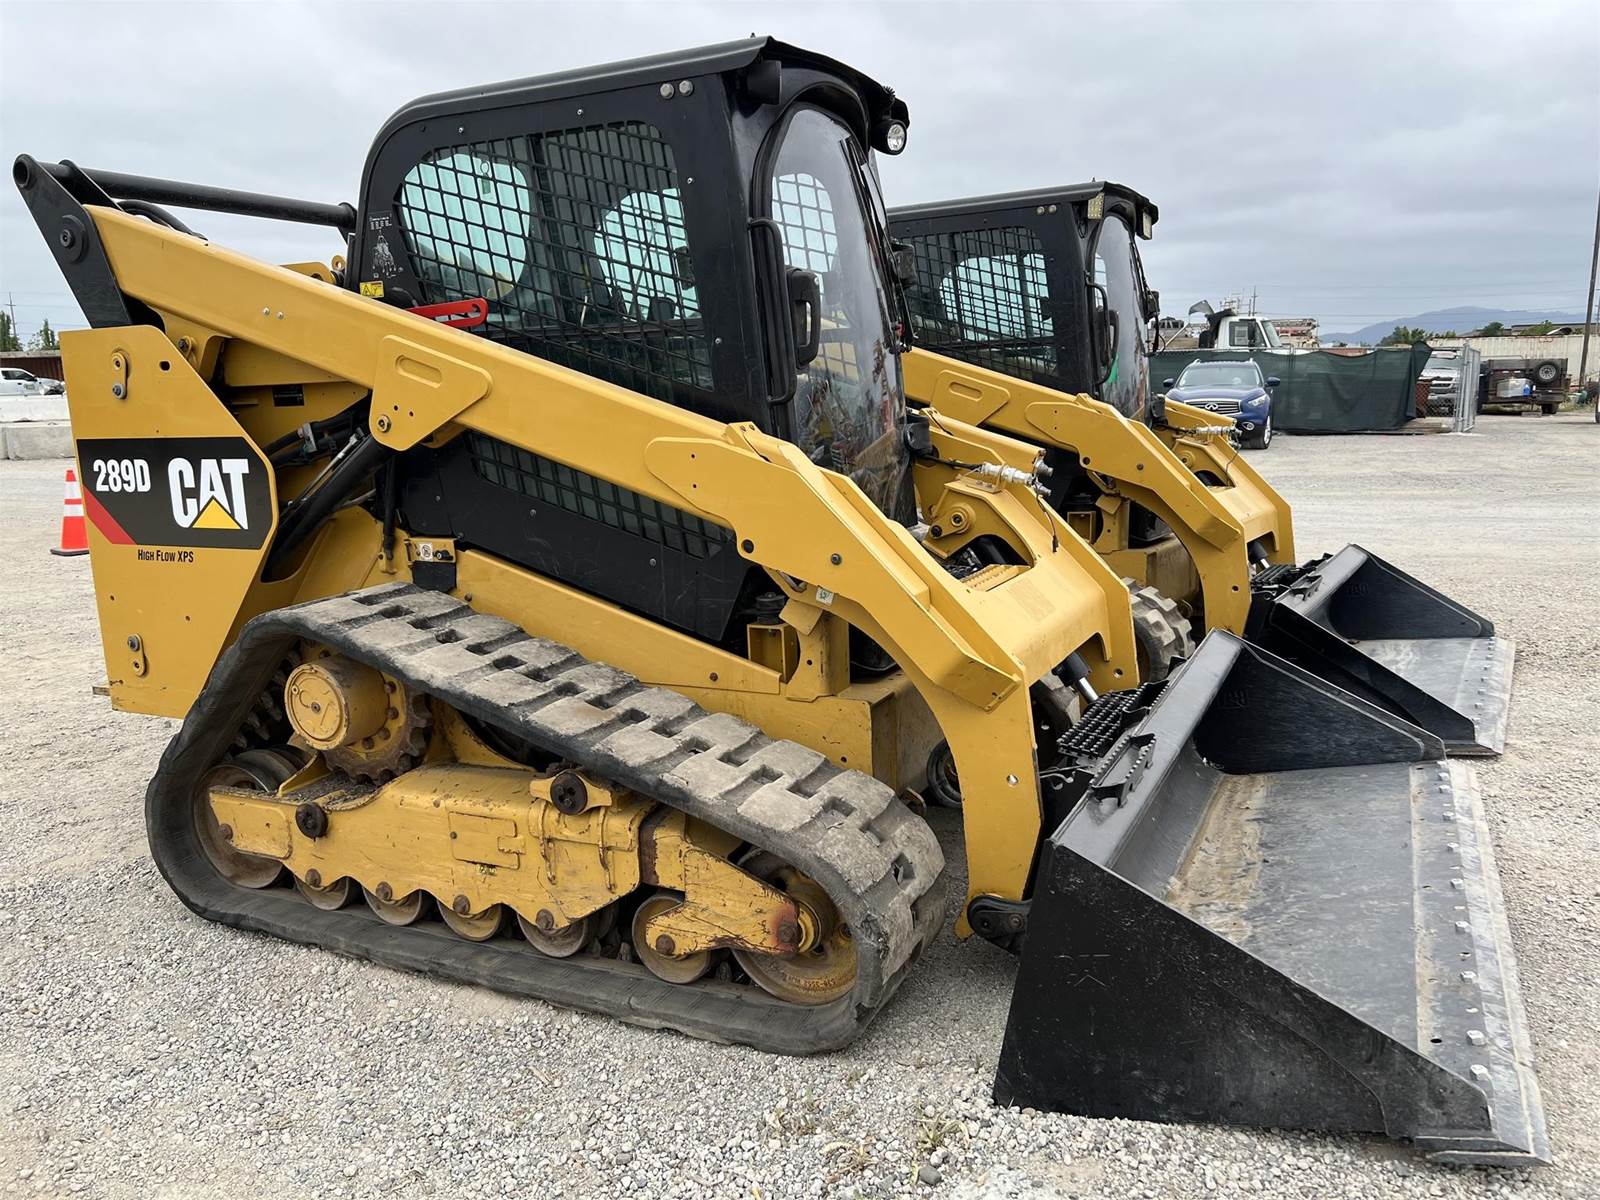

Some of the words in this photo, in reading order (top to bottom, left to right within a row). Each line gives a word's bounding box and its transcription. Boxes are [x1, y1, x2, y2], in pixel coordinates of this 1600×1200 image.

[93, 459, 151, 493] 289D
[167, 457, 250, 530] CAT
[177, 550, 194, 563] XPS
